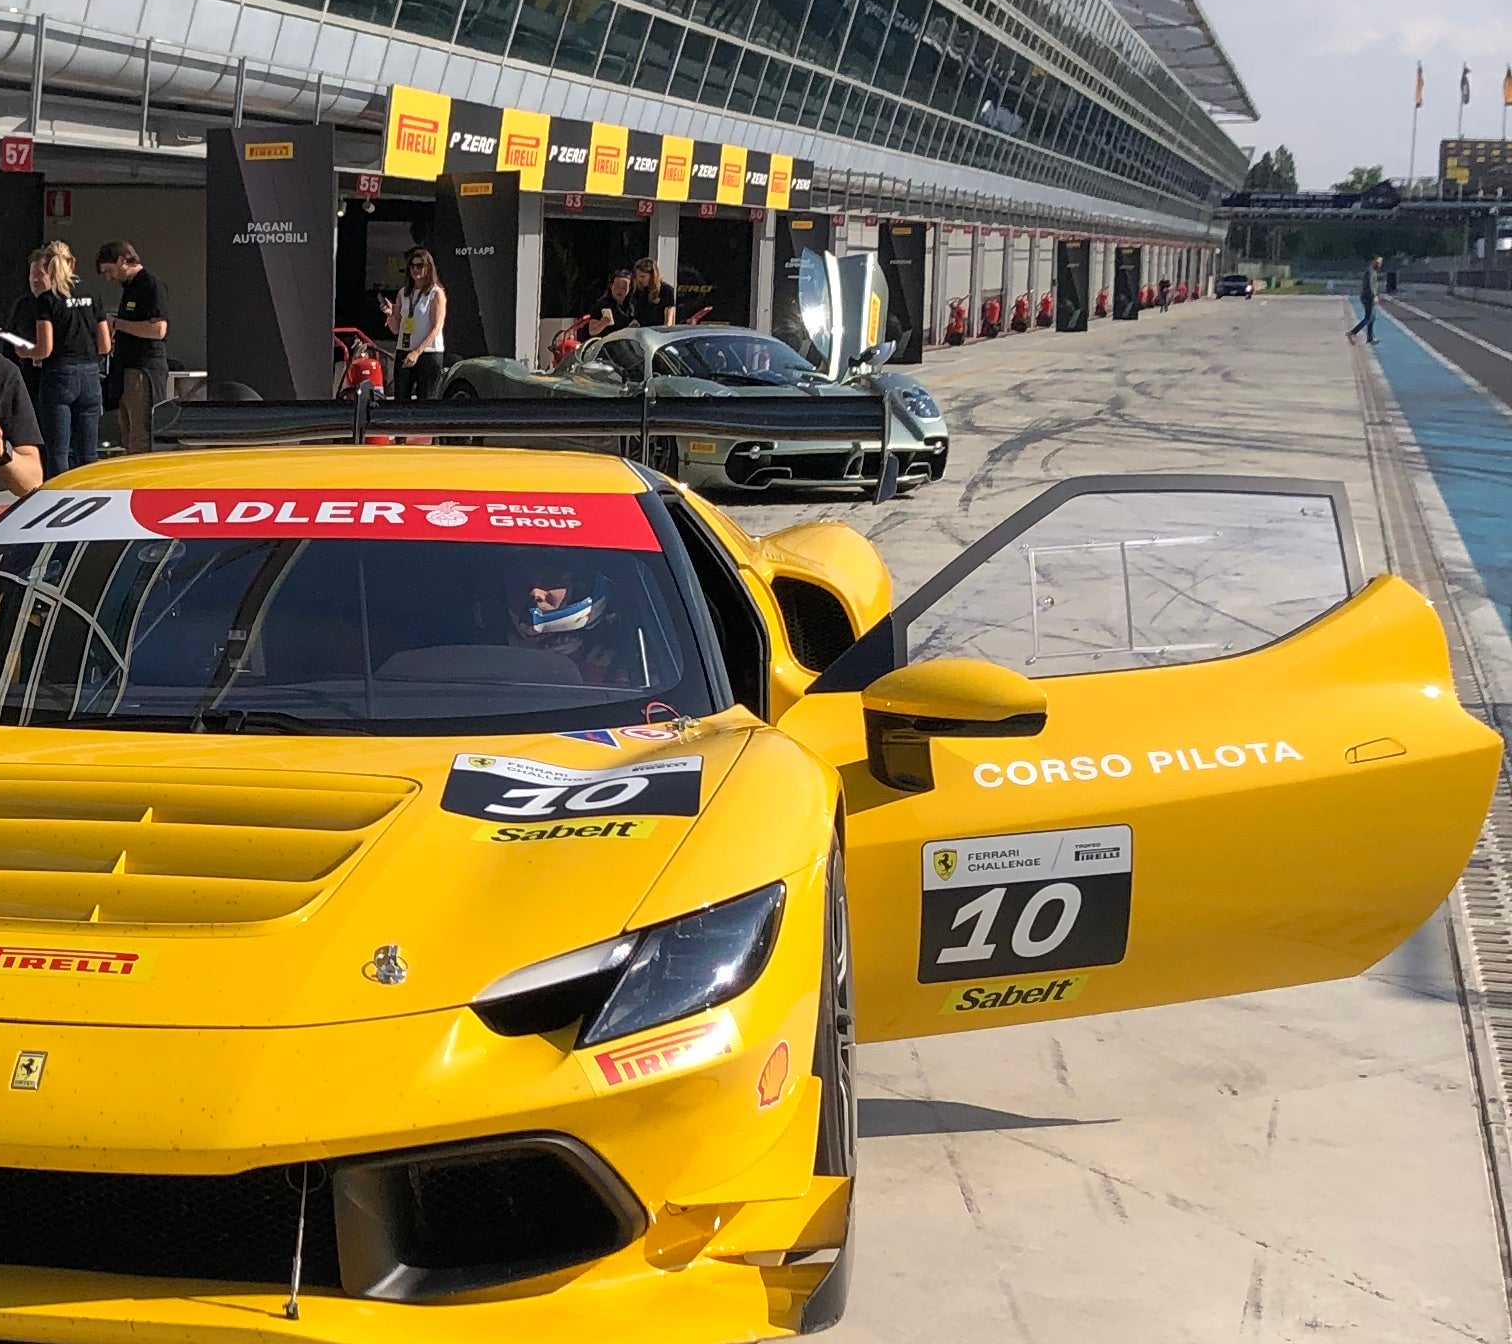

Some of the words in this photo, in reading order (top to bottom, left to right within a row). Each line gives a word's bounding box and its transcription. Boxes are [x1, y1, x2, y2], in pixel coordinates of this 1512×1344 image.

[396, 114, 439, 156] PIRELLI
[449, 132, 461, 149] P
[461, 133, 495, 154] ZERO
[5, 143, 30, 165] 57
[504, 134, 540, 168] PIRELLI
[549, 145, 559, 162] P
[559, 146, 586, 164] ZERO
[593, 145, 620, 176] PIRELLI
[627, 157, 635, 170] P
[634, 156, 657, 173] ZERO
[663, 155, 686, 182] PIRELLI
[698, 164, 718, 180] ZERO
[359, 176, 380, 193] 55
[247, 221, 293, 232] PAGANI
[232, 232, 308, 244] AUTOMOBILI
[455, 246, 472, 256] HOT
[474, 245, 495, 255] LAPS
[66, 297, 93, 307] STAFF
[19, 496, 112, 530] 10
[155, 501, 406, 524] ADLER
[486, 503, 577, 516] PELZER
[490, 515, 583, 529] GROUP
[507, 761, 568, 777] FERRARI
[972, 753, 1132, 789] CORSO
[1147, 740, 1304, 774] PILOTA
[506, 765, 593, 782] CHALLENGE
[483, 776, 649, 816] 10
[490, 821, 638, 843] Sabelt
[967, 849, 1020, 861] FERRARI
[1074, 846, 1121, 862] PIRELLI
[967, 857, 1041, 872] CHALLENGE
[935, 882, 1082, 965] 10
[955, 977, 1073, 1012] Sabelt
